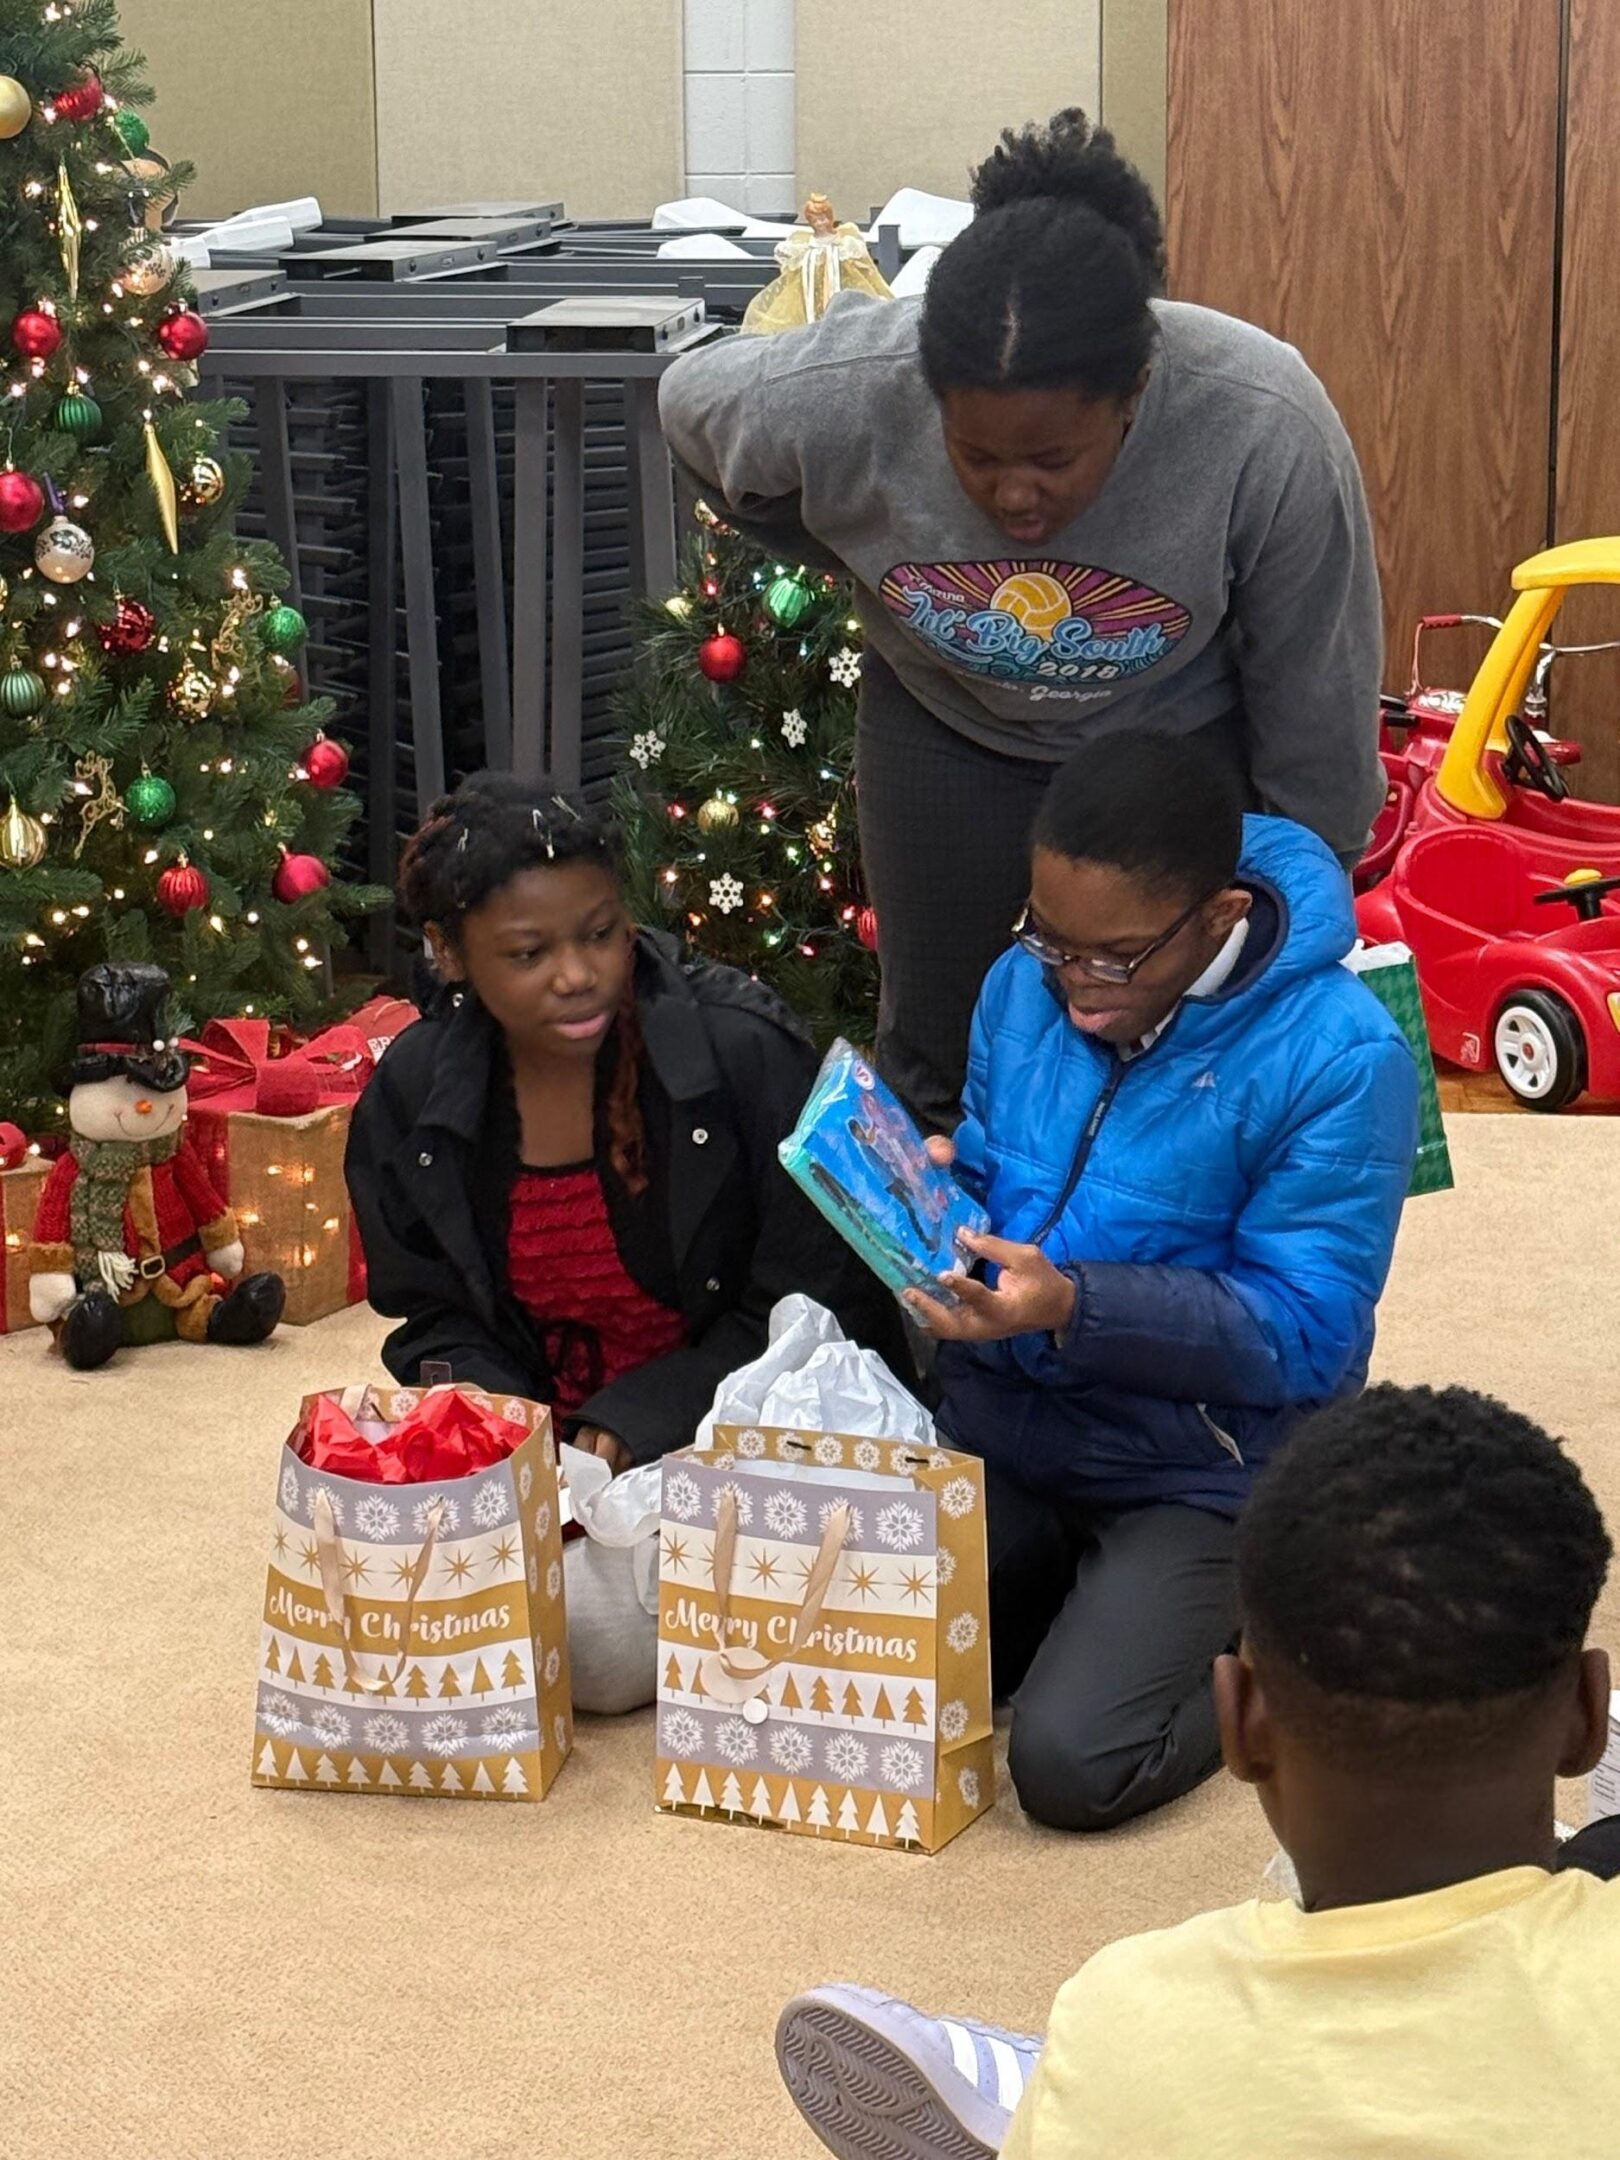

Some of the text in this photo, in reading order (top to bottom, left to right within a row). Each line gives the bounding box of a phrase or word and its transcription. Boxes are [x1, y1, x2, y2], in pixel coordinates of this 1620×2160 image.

[966, 610, 1050, 665] Big
[1050, 617, 1166, 660] South
[1037, 661, 1119, 680] 2018
